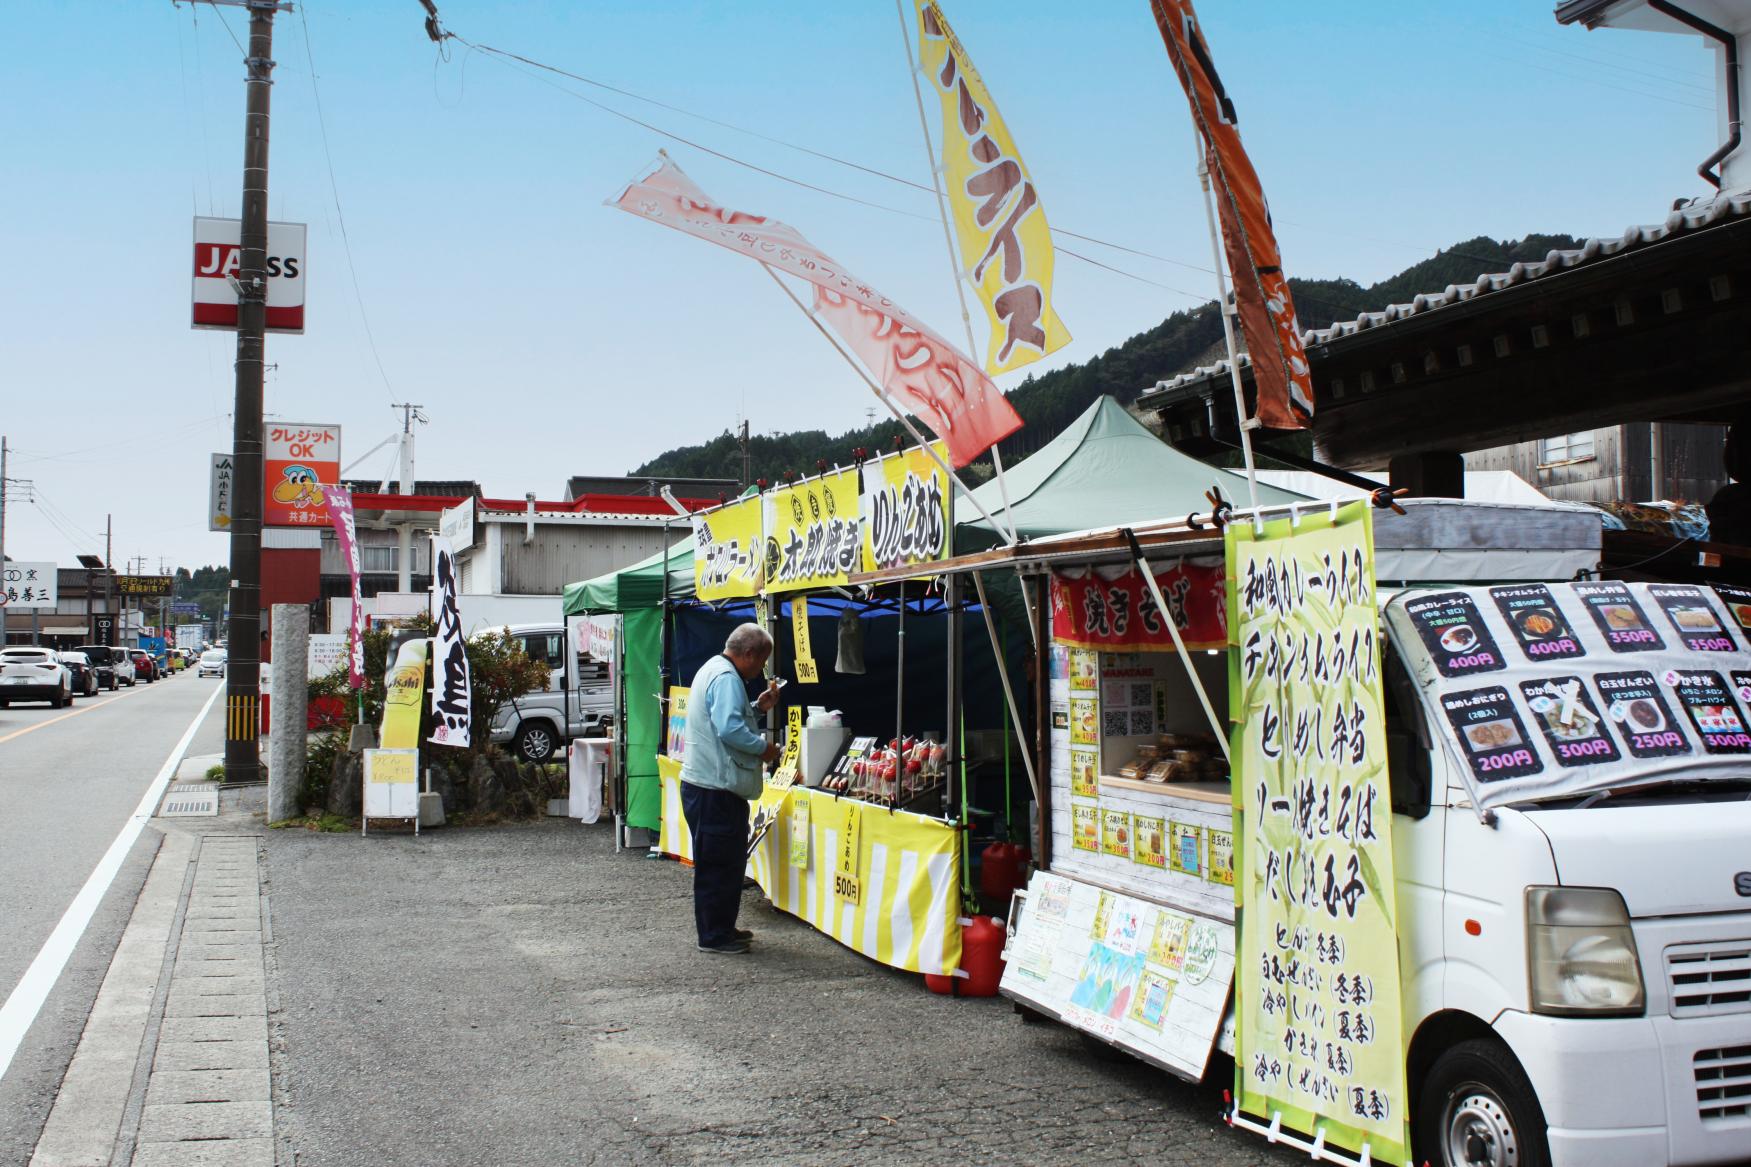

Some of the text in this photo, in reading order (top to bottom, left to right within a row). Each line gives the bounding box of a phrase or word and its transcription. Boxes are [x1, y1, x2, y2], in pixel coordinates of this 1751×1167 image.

[270, 428, 335, 444] クレジット
[289, 444, 314, 459] OK
[873, 474, 942, 561] りんごあめ
[781, 521, 858, 582] 太郎焼き
[1085, 578, 1190, 634] 焼きそば
[1609, 630, 1656, 643] 350円
[1688, 638, 1733, 651] 350円
[1529, 639, 1577, 655] 400円
[1448, 653, 1494, 669] 400円
[1680, 676, 1714, 687] かき氷
[1632, 731, 1683, 748] 250円
[1705, 733, 1751, 747] 300円
[1558, 739, 1612, 759] 300円
[1478, 750, 1534, 771] 200円
[835, 876, 857, 900] 500円
